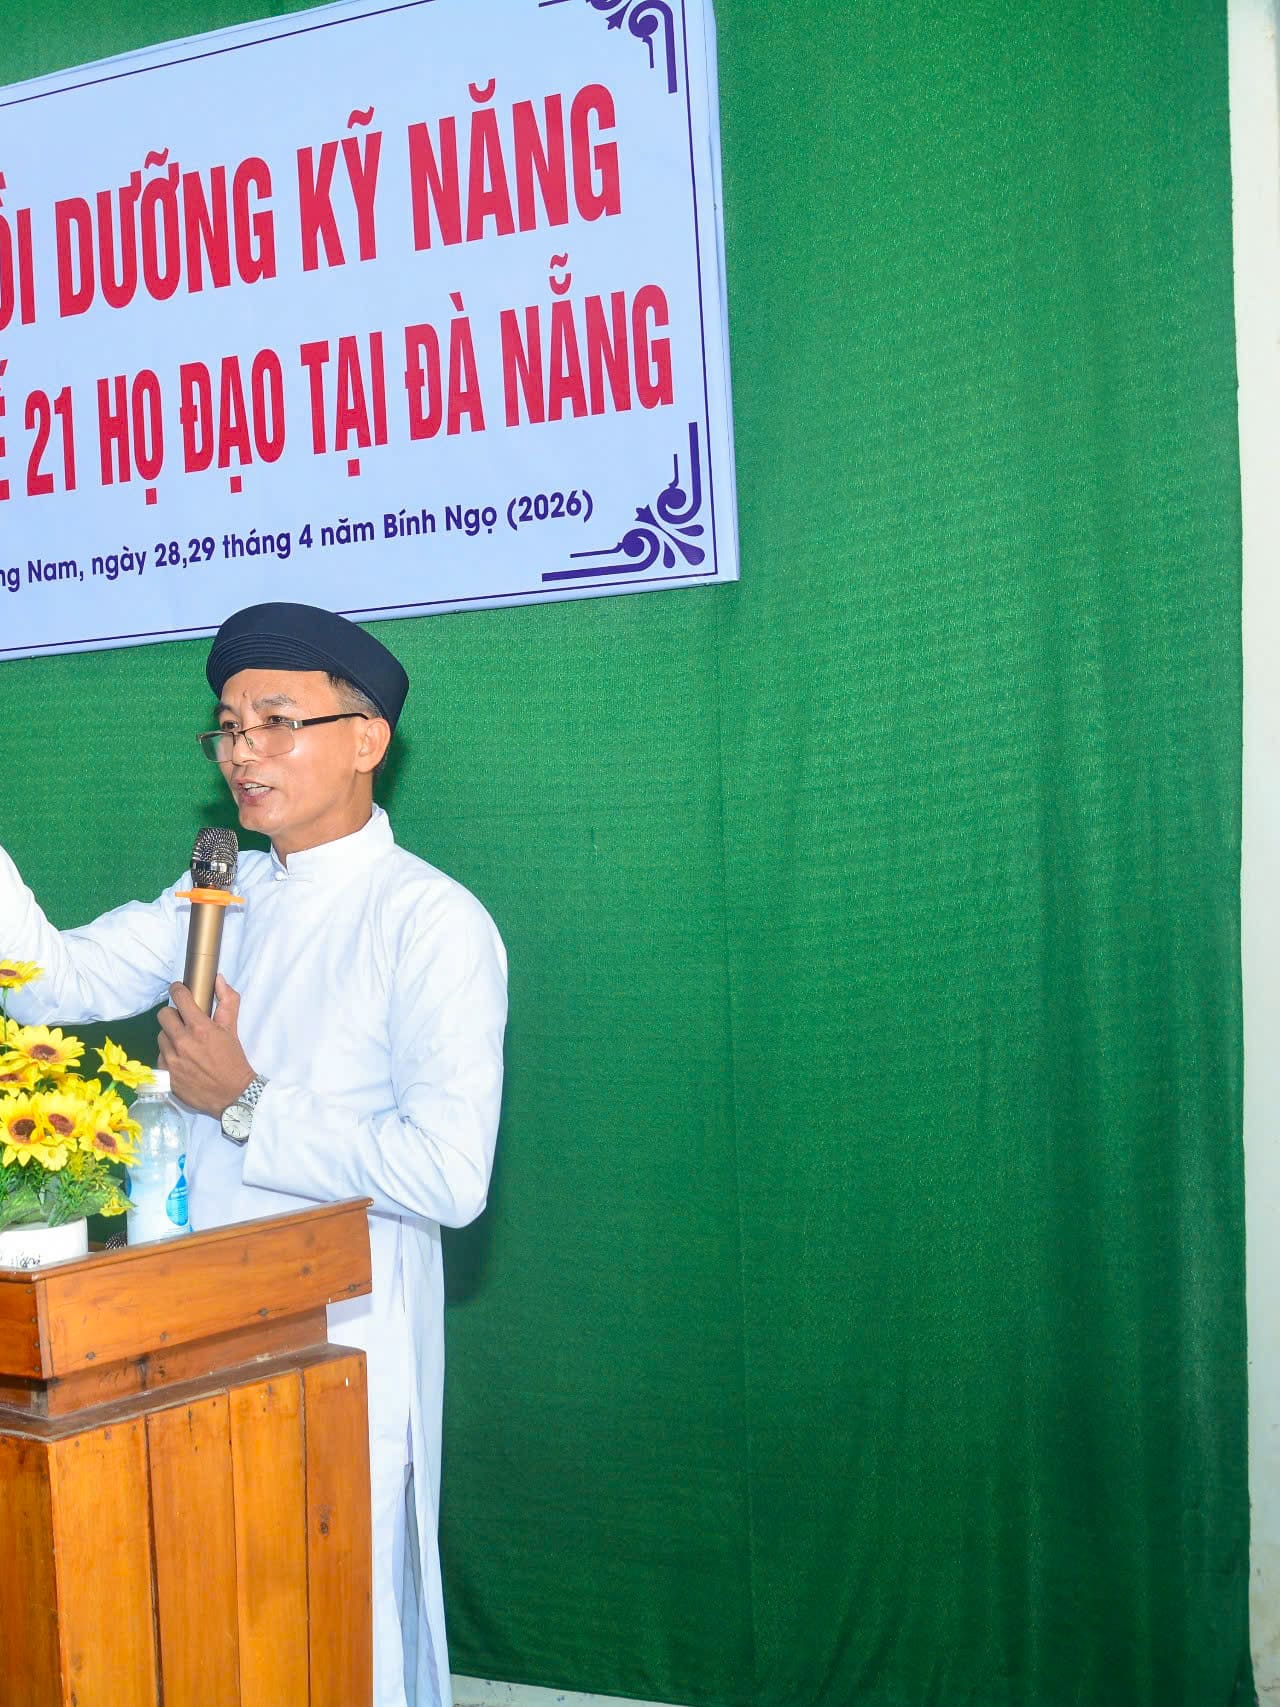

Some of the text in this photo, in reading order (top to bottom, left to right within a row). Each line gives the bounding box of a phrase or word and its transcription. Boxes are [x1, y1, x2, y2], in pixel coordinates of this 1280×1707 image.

[55, 149, 277, 317] DƯỠNG
[297, 107, 382, 271] KỸ
[408, 79, 621, 251] NĂNG
[25, 386, 77, 497] 21
[97, 369, 164, 505] HỌ
[179, 348, 286, 493] ĐẠO
[300, 331, 388, 477] TẠI
[405, 292, 486, 440] ĐÀ
[500, 255, 674, 427] NẴNG
[27, 558, 84, 583] Nam,
[91, 545, 147, 581] ngày
[154, 536, 216, 569] 28,29
[222, 528, 291, 560] tháng
[298, 523, 313, 549] 4
[320, 517, 375, 547] năm
[383, 508, 436, 539] Bính
[445, 504, 498, 537] Ngọ
[506, 489, 594, 532] (2026)
